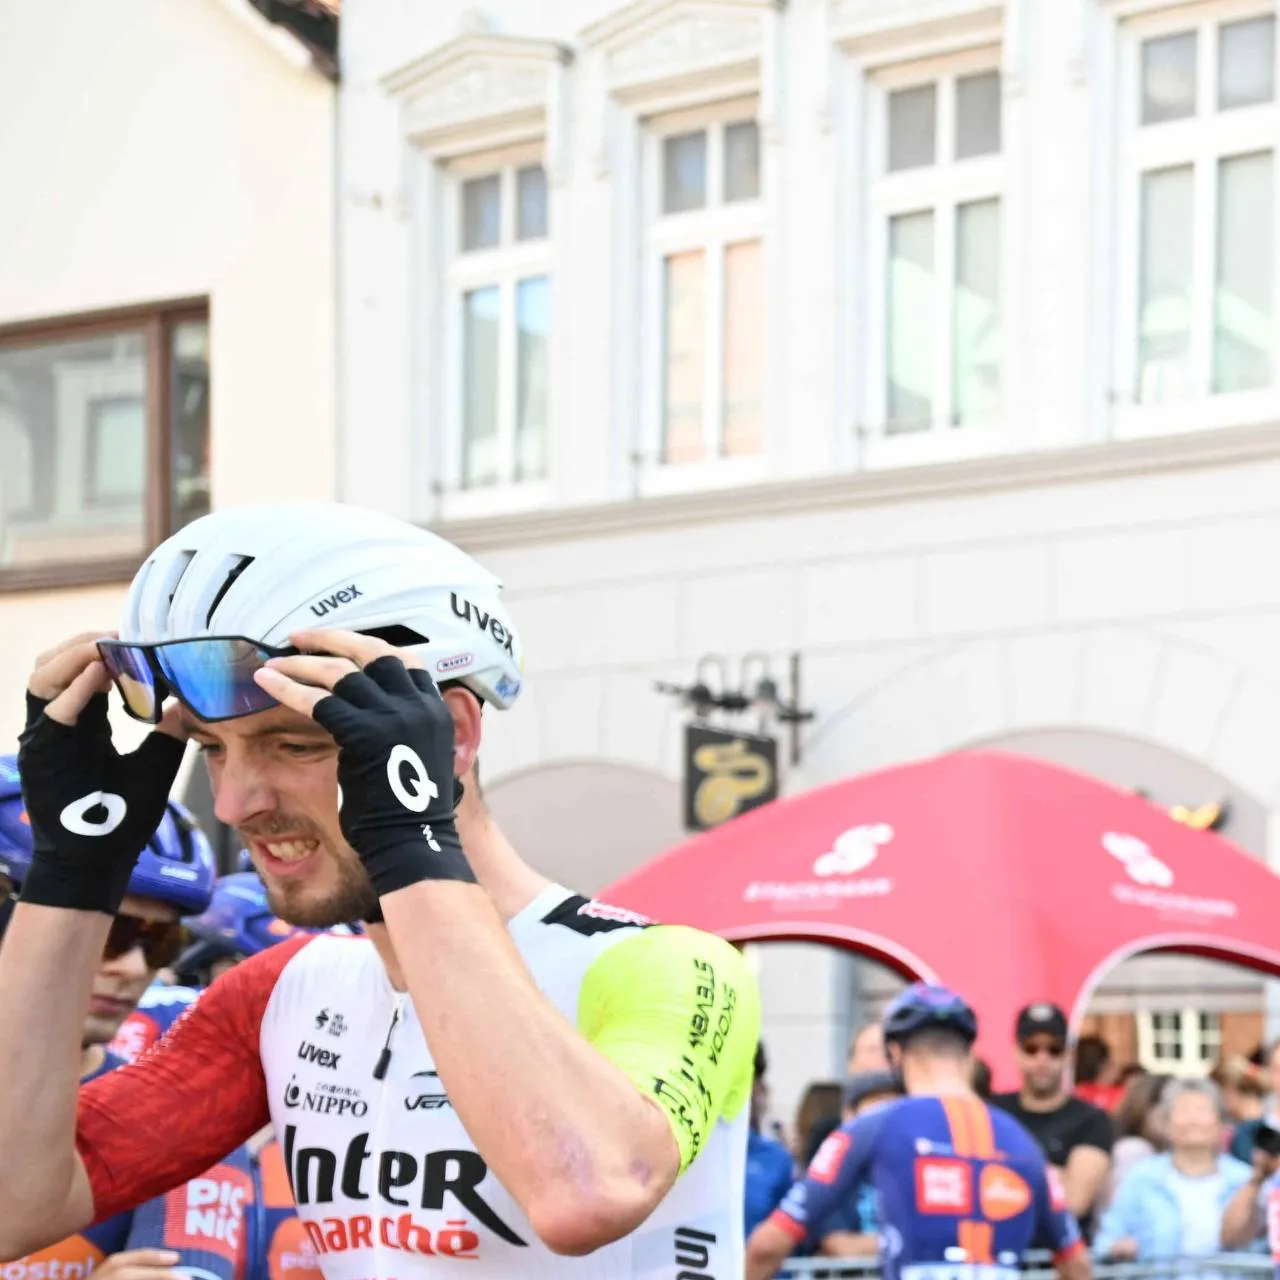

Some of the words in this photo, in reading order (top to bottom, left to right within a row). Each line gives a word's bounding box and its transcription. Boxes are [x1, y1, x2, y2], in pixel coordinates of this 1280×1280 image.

[310, 584, 364, 618] uvex
[450, 591, 514, 657] uvex
[298, 1040, 341, 1071] uvex
[301, 1091, 368, 1118] NIPPO
